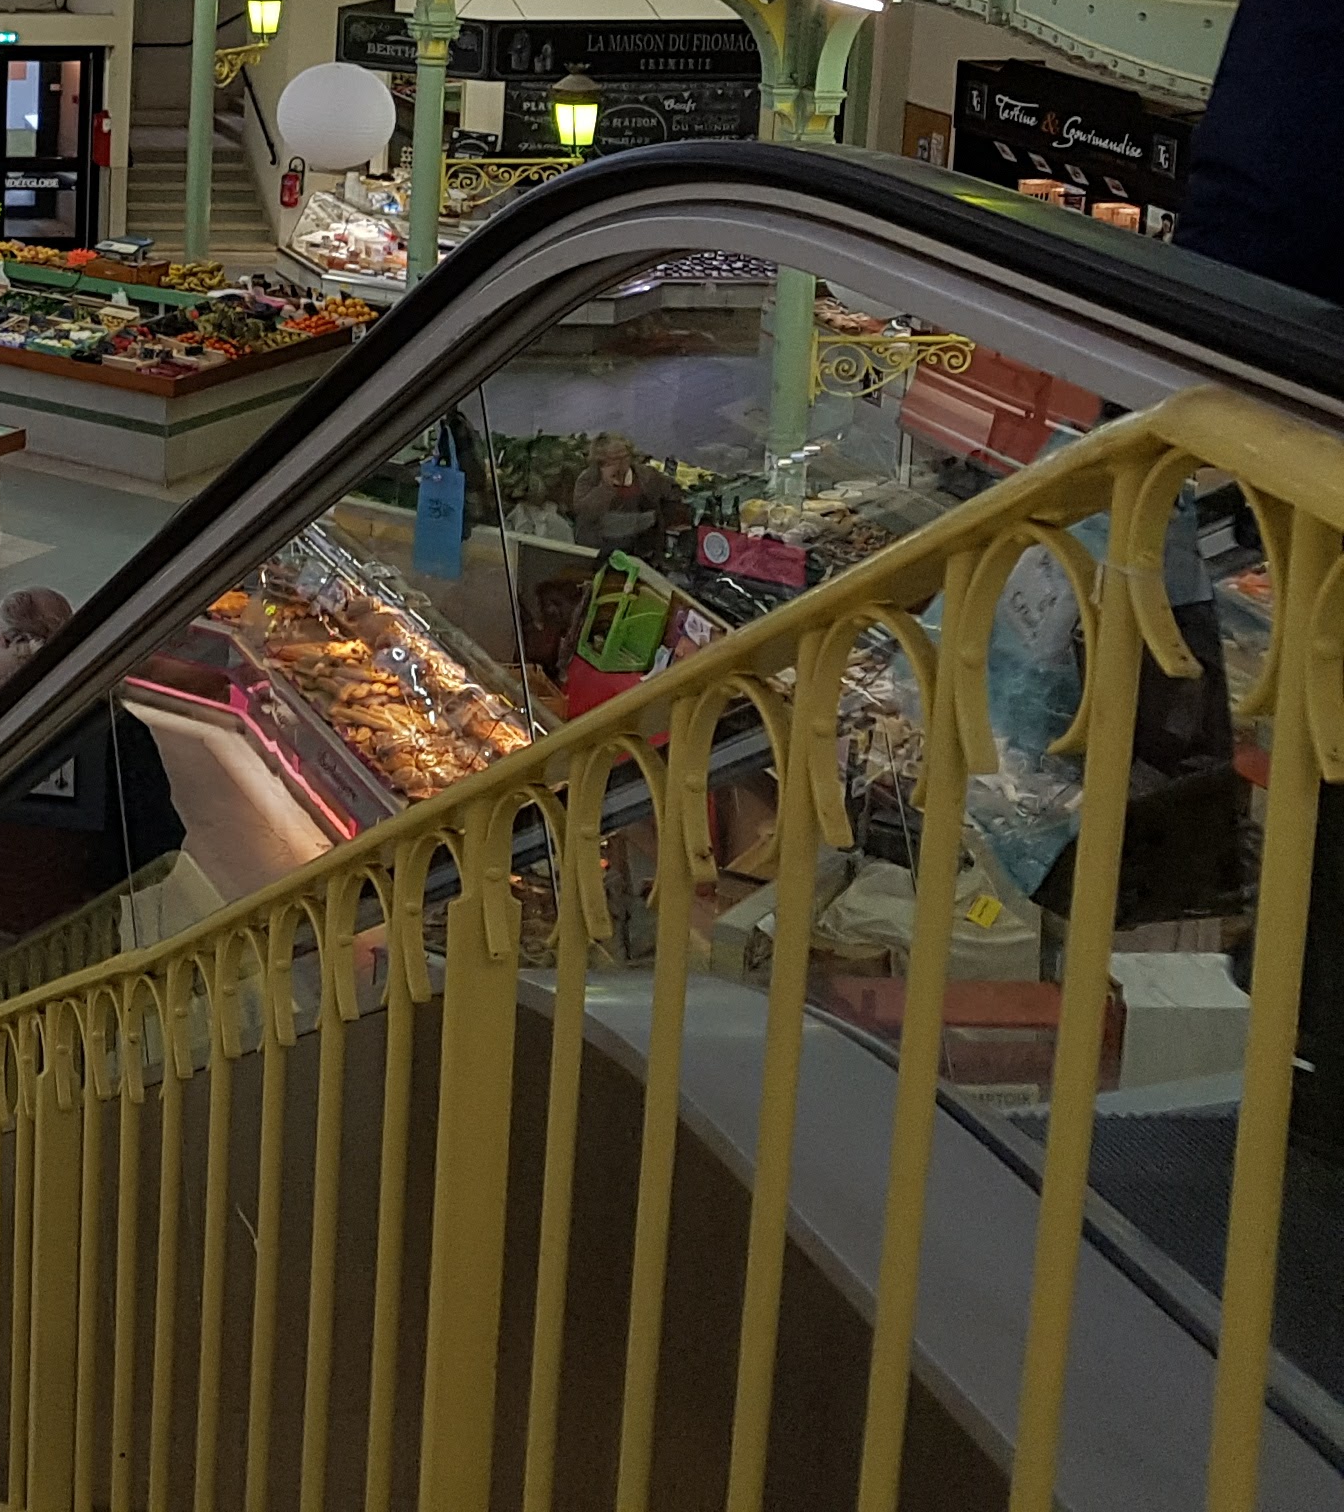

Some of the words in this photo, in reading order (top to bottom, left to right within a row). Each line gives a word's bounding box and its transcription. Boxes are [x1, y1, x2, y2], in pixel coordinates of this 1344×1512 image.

[610, 33, 663, 52] MAISON
[668, 34, 690, 52] DU
[692, 34, 759, 52] FROMAG
[995, 94, 1040, 127] Tartine
[1052, 115, 1144, 158] Gourmandise
